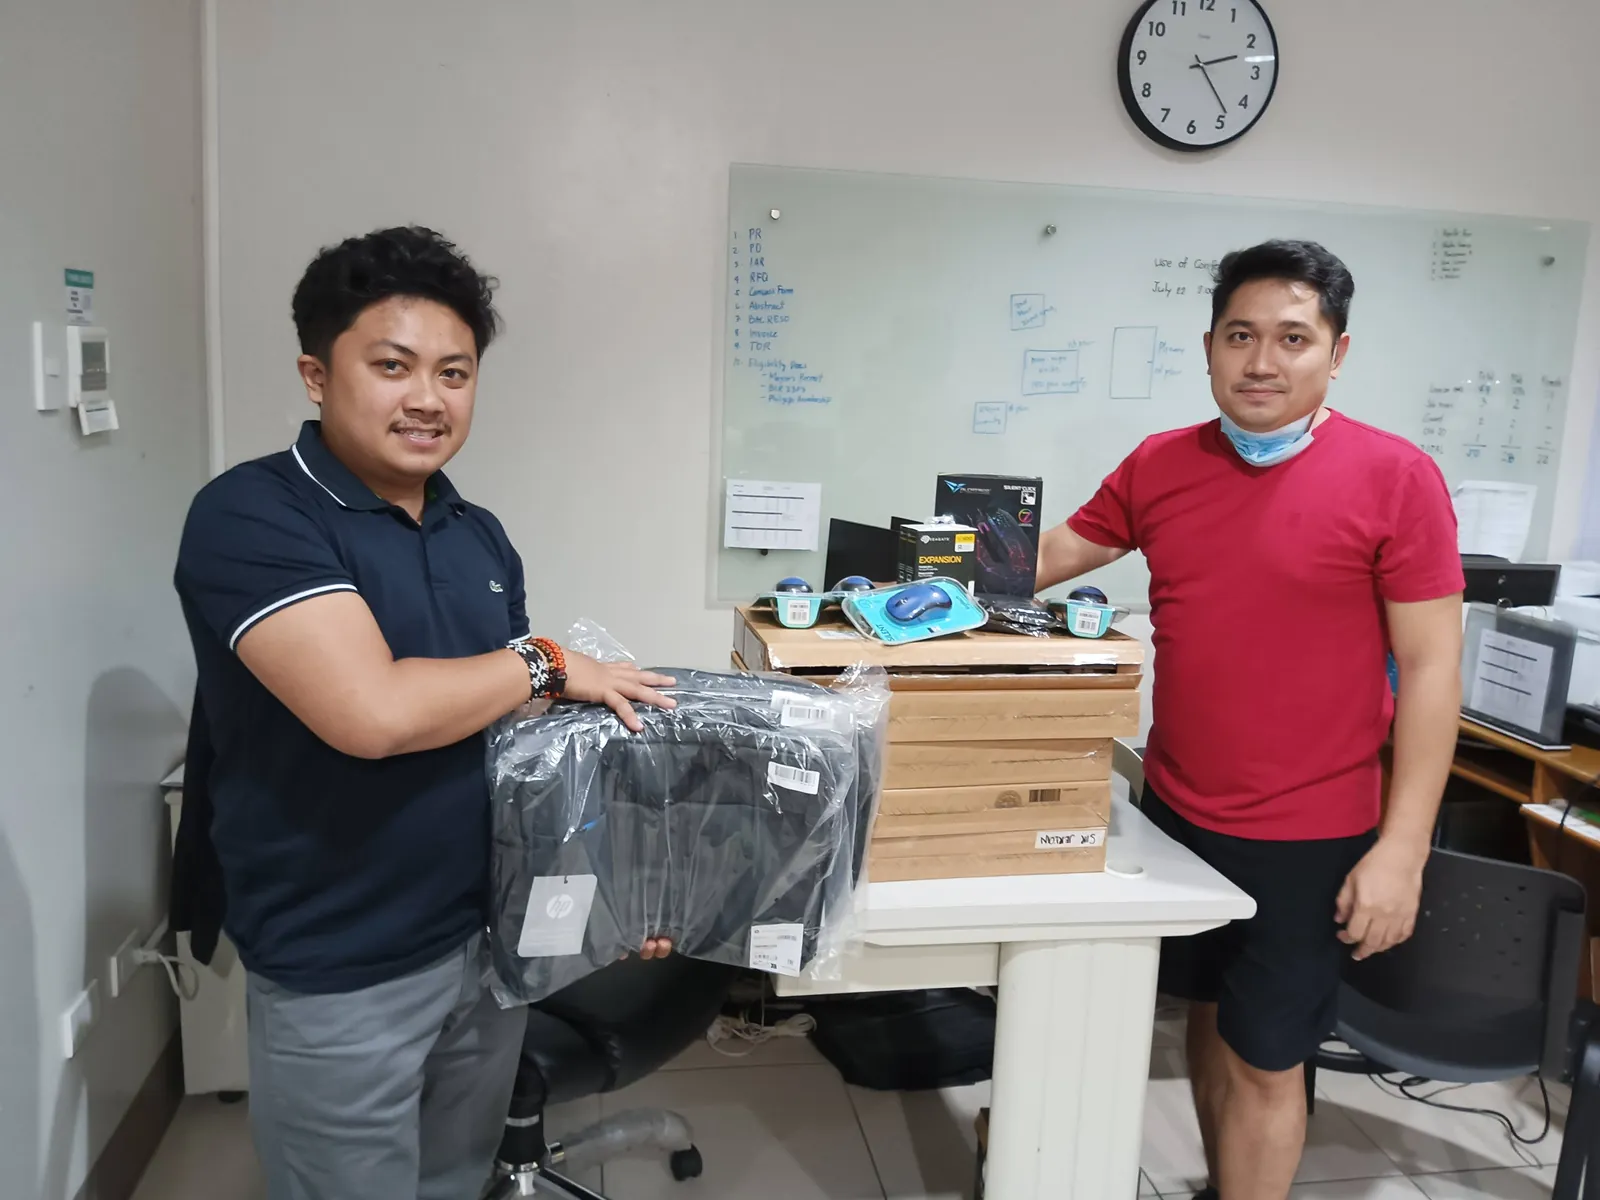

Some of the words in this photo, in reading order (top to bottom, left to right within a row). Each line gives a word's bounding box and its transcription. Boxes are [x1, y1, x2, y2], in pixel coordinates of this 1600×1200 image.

[1172, 1, 1187, 16] 11
[1200, 0, 1215, 11] 12
[1230, 8, 1237, 23] 1
[1148, 21, 1166, 37] 10
[1246, 33, 1256, 49] 2
[1136, 50, 1147, 65] 9
[1250, 65, 1261, 80] 3
[1141, 82, 1152, 97] 8
[1238, 94, 1249, 109] 4
[1160, 107, 1171, 123] 7
[1215, 115, 1226, 129] 5
[1186, 120, 1196, 134] 6
[749, 228, 762, 240] PR
[750, 243, 762, 253] PO
[750, 257, 765, 267] IAR
[1154, 258, 1173, 268] Use
[1178, 256, 1188, 269] of
[750, 272, 768, 282] RFQ
[1152, 281, 1172, 297] July
[749, 301, 785, 310] Abstract
[750, 341, 771, 351] TOR
[918, 555, 962, 564] EXPANSION
